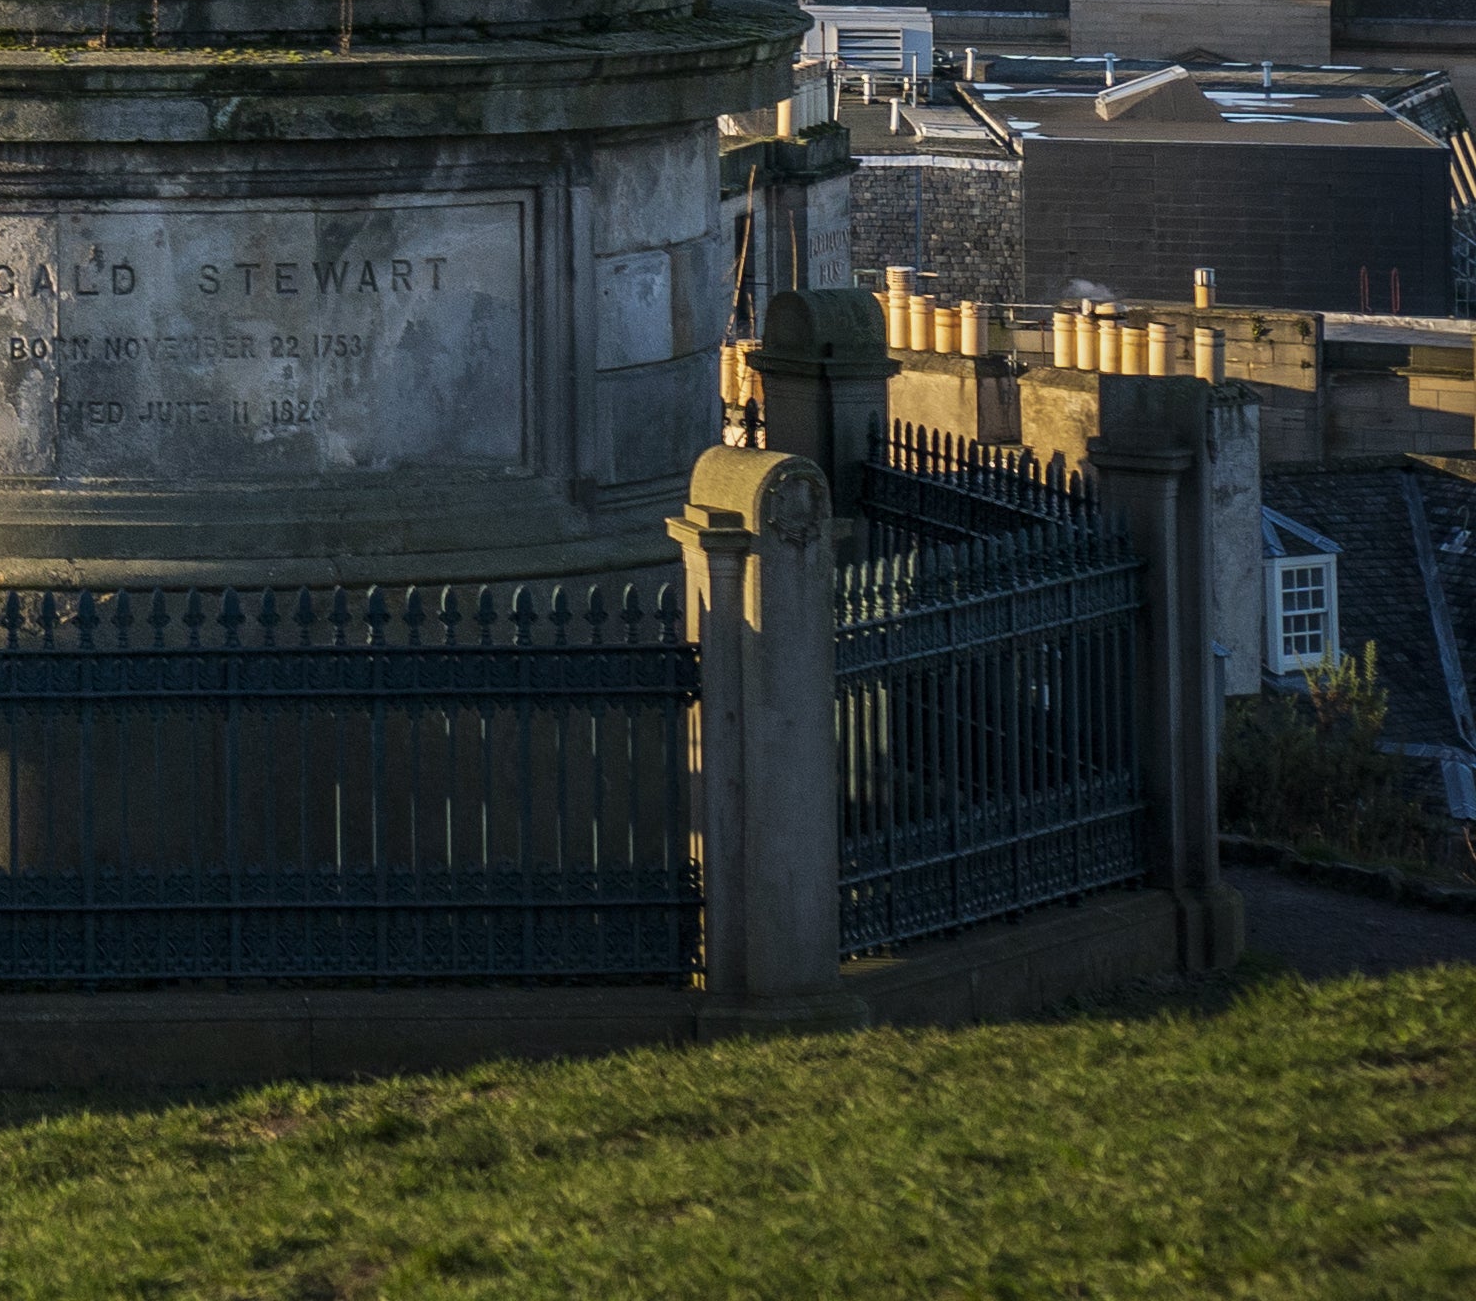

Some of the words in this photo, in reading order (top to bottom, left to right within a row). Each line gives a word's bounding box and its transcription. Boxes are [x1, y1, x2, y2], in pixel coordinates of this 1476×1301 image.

[197, 256, 448, 296] STEWART
[270, 334, 301, 359] 22
[312, 333, 364, 358] 1753
